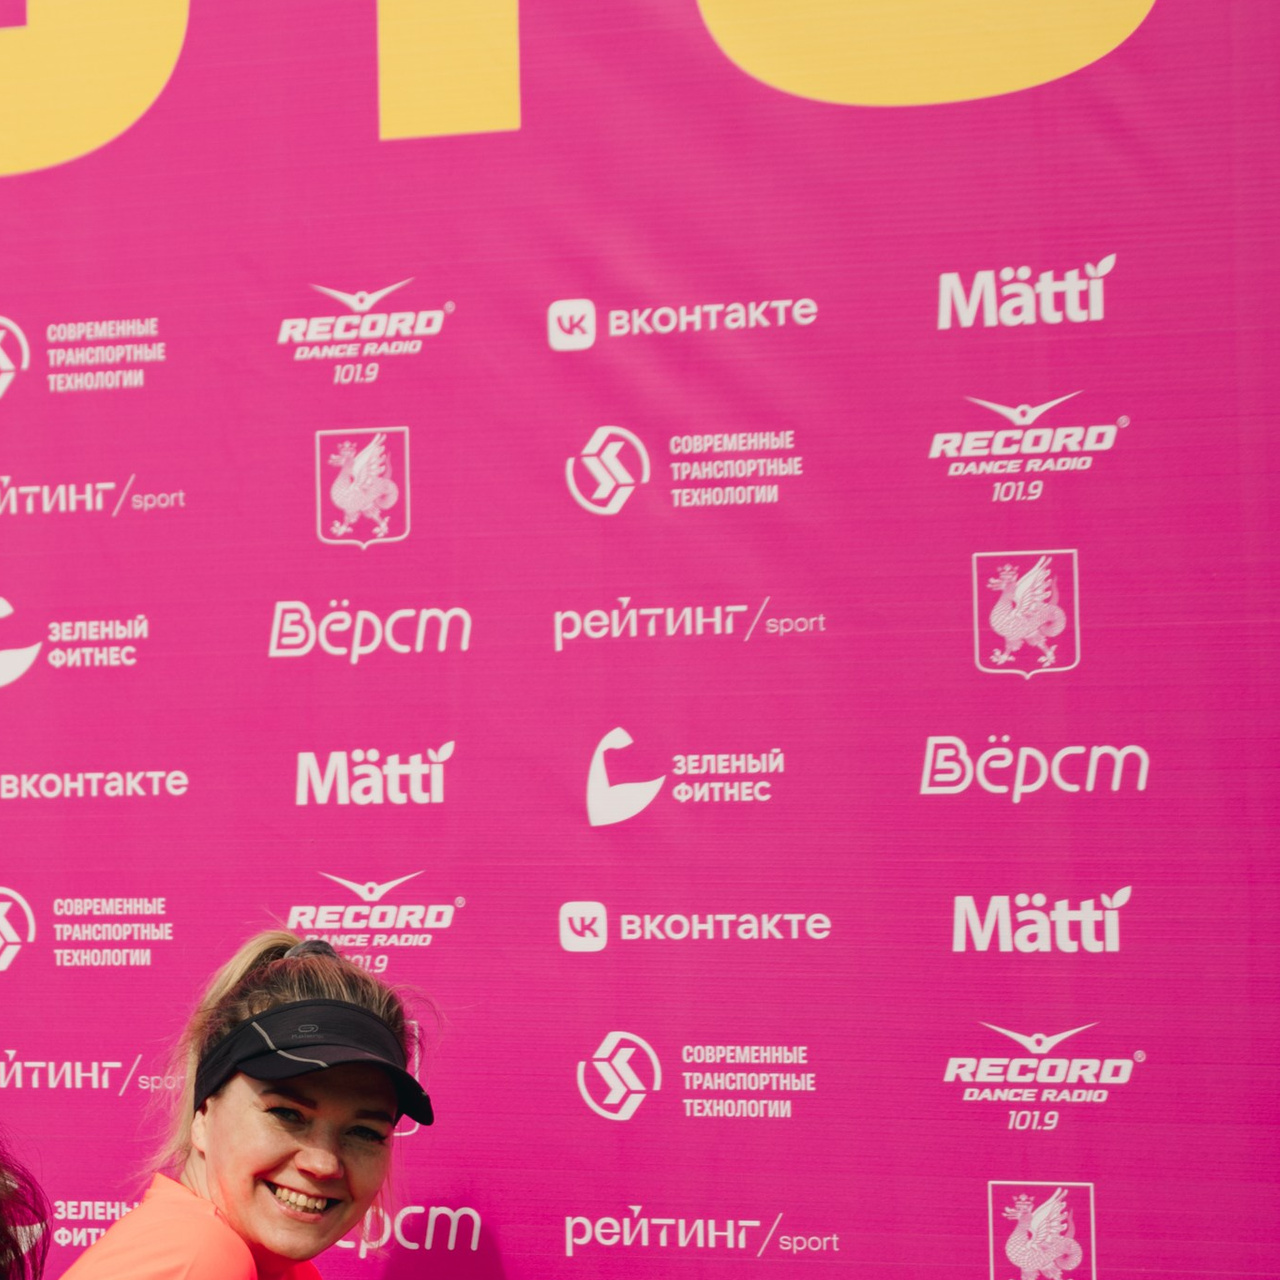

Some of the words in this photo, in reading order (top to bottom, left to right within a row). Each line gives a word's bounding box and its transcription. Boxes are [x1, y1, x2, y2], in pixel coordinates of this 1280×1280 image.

[938, 254, 1116, 330] Mätti
[609, 298, 818, 337] вконтакте
[47, 318, 158, 342] СОВРЕМЕННЫЕ
[47, 342, 166, 367] ТРАНСПОРТНЫЕ
[294, 344, 360, 360] DANCE
[363, 340, 422, 356] RADIO
[47, 369, 144, 392] ТЕХНОЛОГИИ
[334, 363, 379, 384] 101.9
[670, 430, 794, 454] СОВРЕМЕННЫЕ
[670, 457, 803, 480] ТРАНСПОРТНЫЕ
[948, 460, 1023, 476] DANCE
[1025, 456, 1093, 472] RADIO
[671, 485, 778, 507] ТЕХНОЛОГИИ
[992, 480, 1043, 502] 101.9
[48, 614, 148, 642] ЗЕЛЕНЫЙ
[48, 646, 136, 668] ФИТНЕС
[673, 748, 784, 775] ЗЕЛЕНЫЙ
[296, 741, 455, 805] Mätti
[0, 770, 189, 799] вконтакте
[672, 781, 771, 803] ФИТНЕС
[53, 897, 166, 916] СОВРЕМЕННЫЕ
[620, 913, 831, 940] вконтакте
[952, 886, 1132, 953] Mätti
[54, 923, 173, 941] ТРАНСПОРТНЫЕ
[372, 934, 432, 946] RADIO
[54, 949, 151, 966] ТЕХНОЛОГИИ
[682, 1045, 808, 1064] СОВРЕМЕННЫЕ
[682, 1072, 816, 1091] ТРАНСПОРТНЫЕ
[963, 1088, 1038, 1101] DANCE
[1041, 1089, 1108, 1102] RADIO
[682, 1099, 791, 1118] ТЕХНОЛОГИИ
[1008, 1111, 1059, 1130] 101.9
